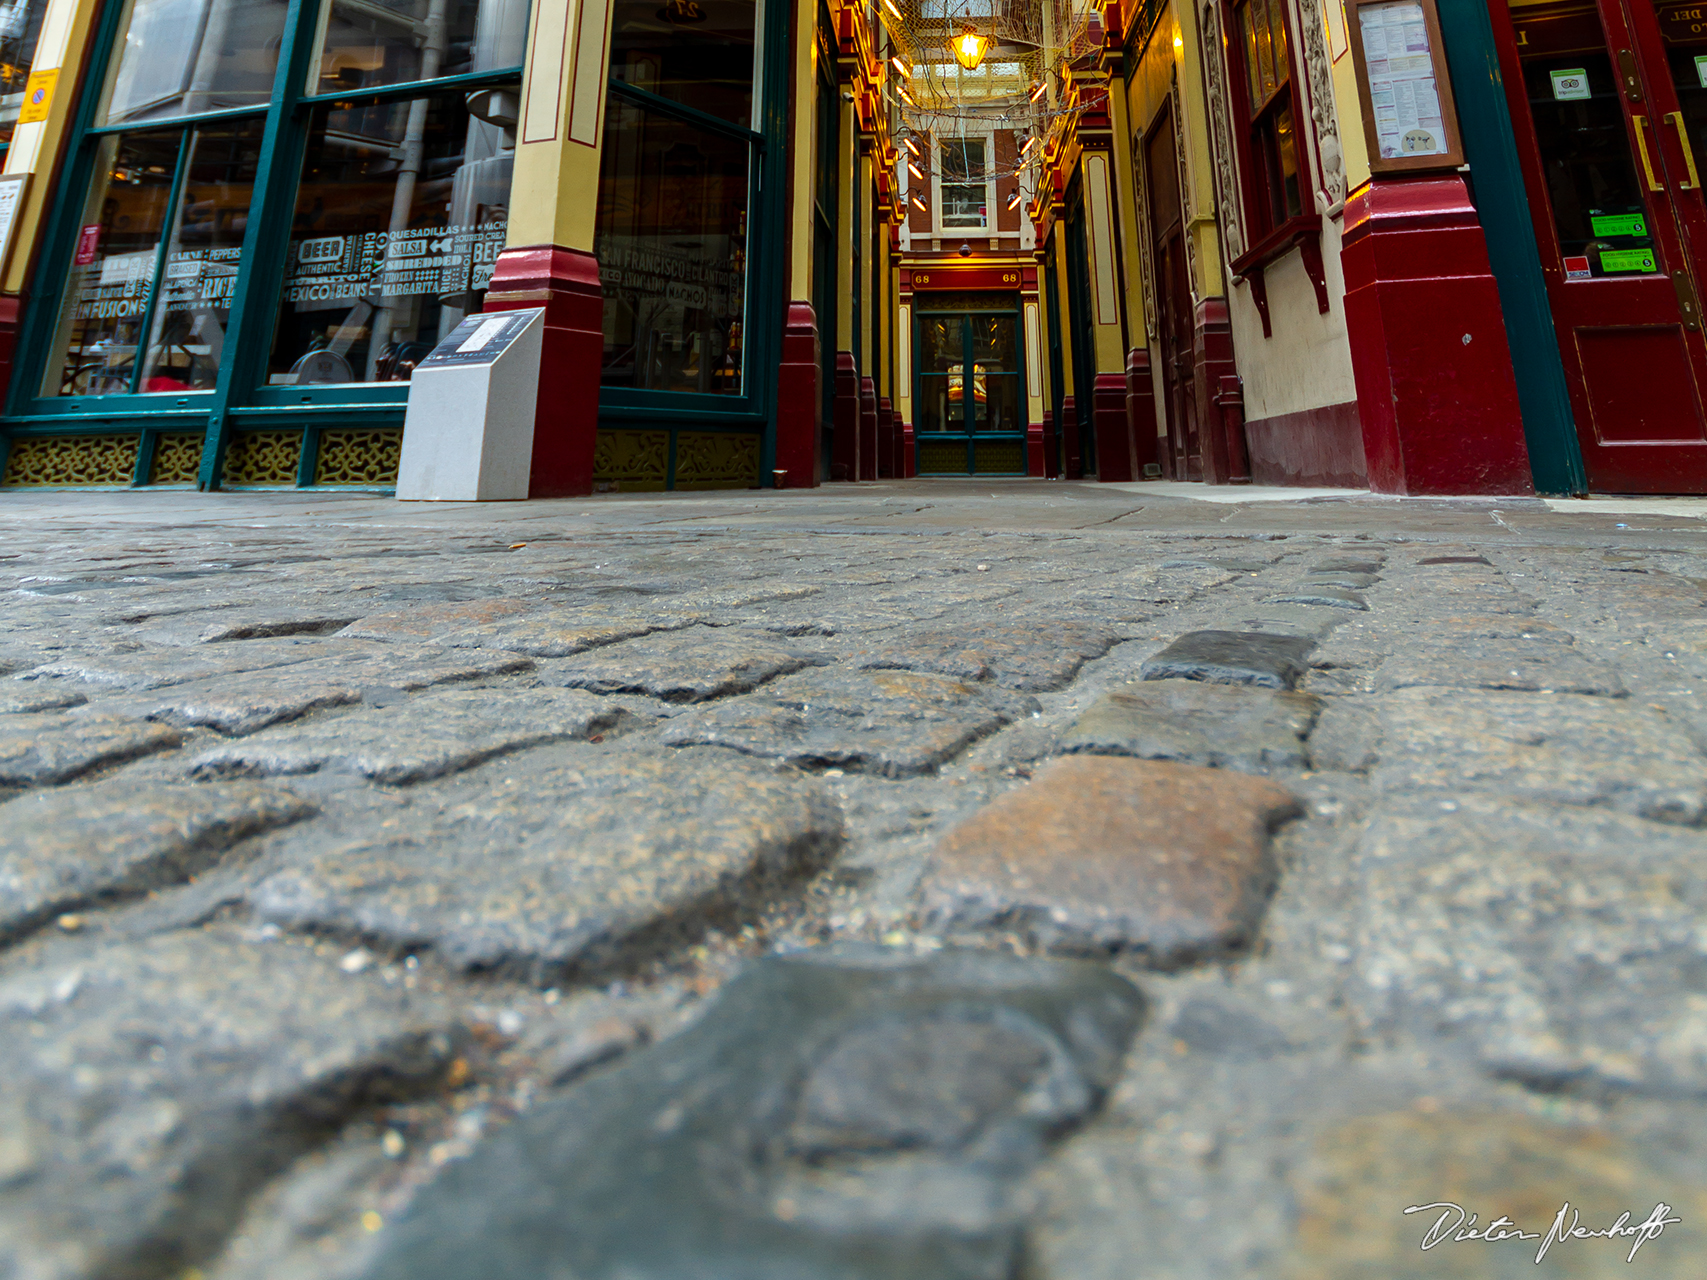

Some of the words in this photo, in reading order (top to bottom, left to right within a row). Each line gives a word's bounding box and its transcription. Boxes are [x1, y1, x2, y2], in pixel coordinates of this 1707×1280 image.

[389, 225, 460, 241] QUESADILLAS
[209, 246, 242, 260] PEPPERS
[301, 241, 340, 260] BEER
[359, 232, 377, 280] CHEESE
[392, 242, 423, 256] SALSA
[295, 261, 342, 276] AUTHENTIC
[386, 255, 462, 272] SHREDDED
[460, 254, 472, 291] NACHOS
[625, 250, 686, 281] FRANCISCO
[201, 276, 238, 298] RICE
[441, 268, 453, 293] RICE
[915, 275, 930, 284] 68
[1002, 273, 1017, 283] 68
[335, 283, 367, 299] BEANS
[382, 281, 440, 296] MARGARITA
[669, 286, 705, 305] NACHOS
[77, 299, 140, 319] INFUSION
